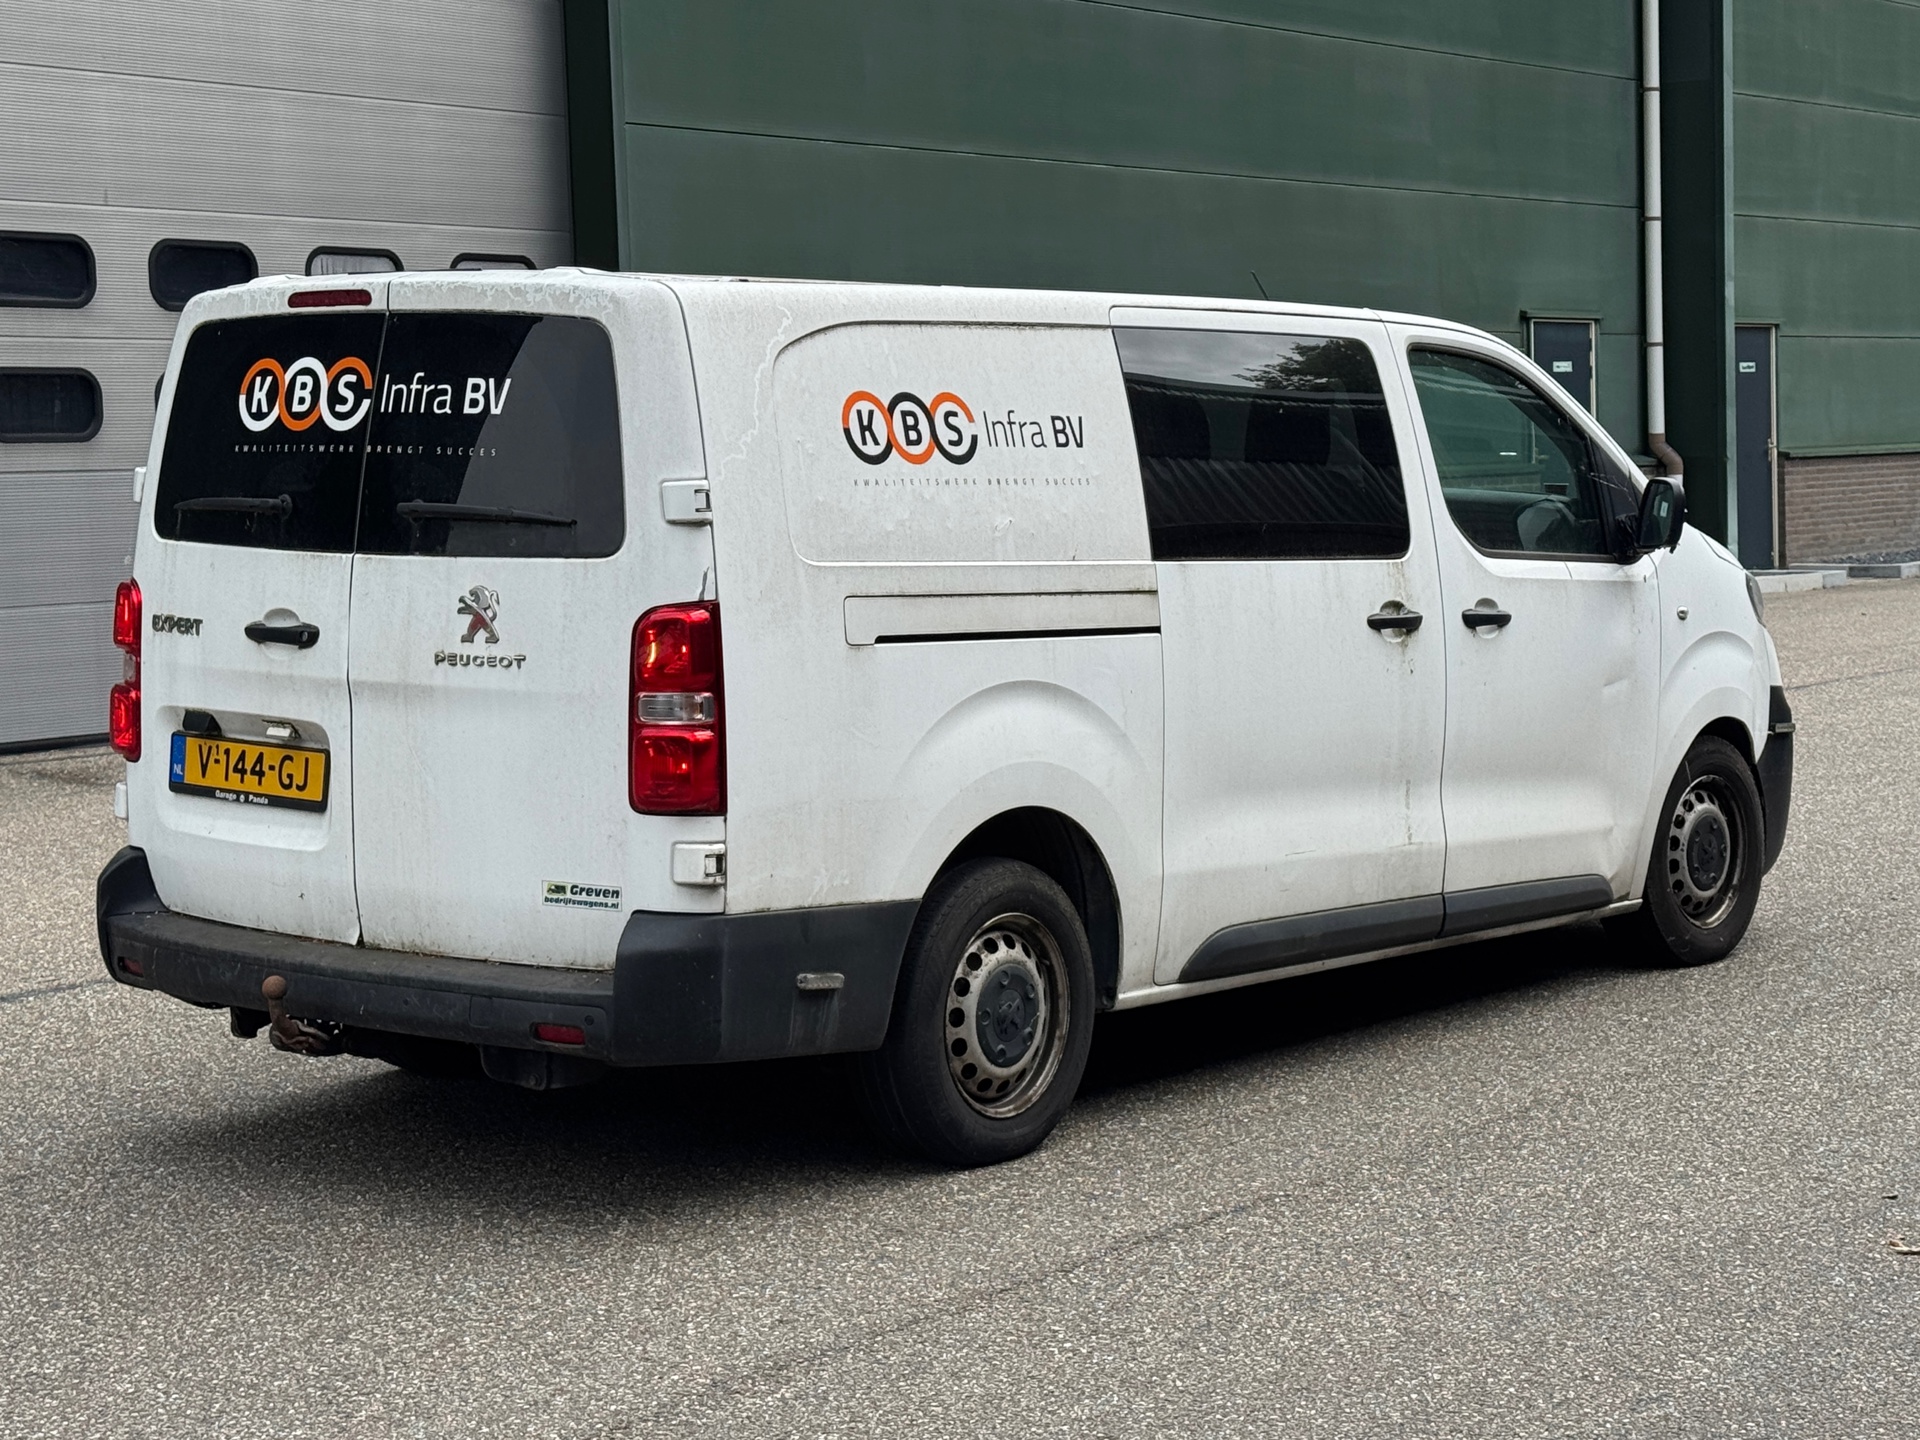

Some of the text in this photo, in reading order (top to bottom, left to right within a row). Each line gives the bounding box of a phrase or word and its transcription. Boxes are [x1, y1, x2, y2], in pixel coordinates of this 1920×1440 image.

[251, 372, 512, 415] KBS Infra BV
[856, 408, 1084, 448] KBS Infra BV
[234, 444, 497, 457] KWALITEITSWERK BRENGT SUCCES
[1045, 477, 1090, 486] SUCCES
[152, 613, 203, 637] EXPERT
[434, 650, 527, 669] PEUGEOT
[173, 763, 183, 775] NL
[248, 794, 268, 805] Panda
[570, 884, 620, 899] Greven
[544, 895, 619, 909] bedrijfswagens.nl
